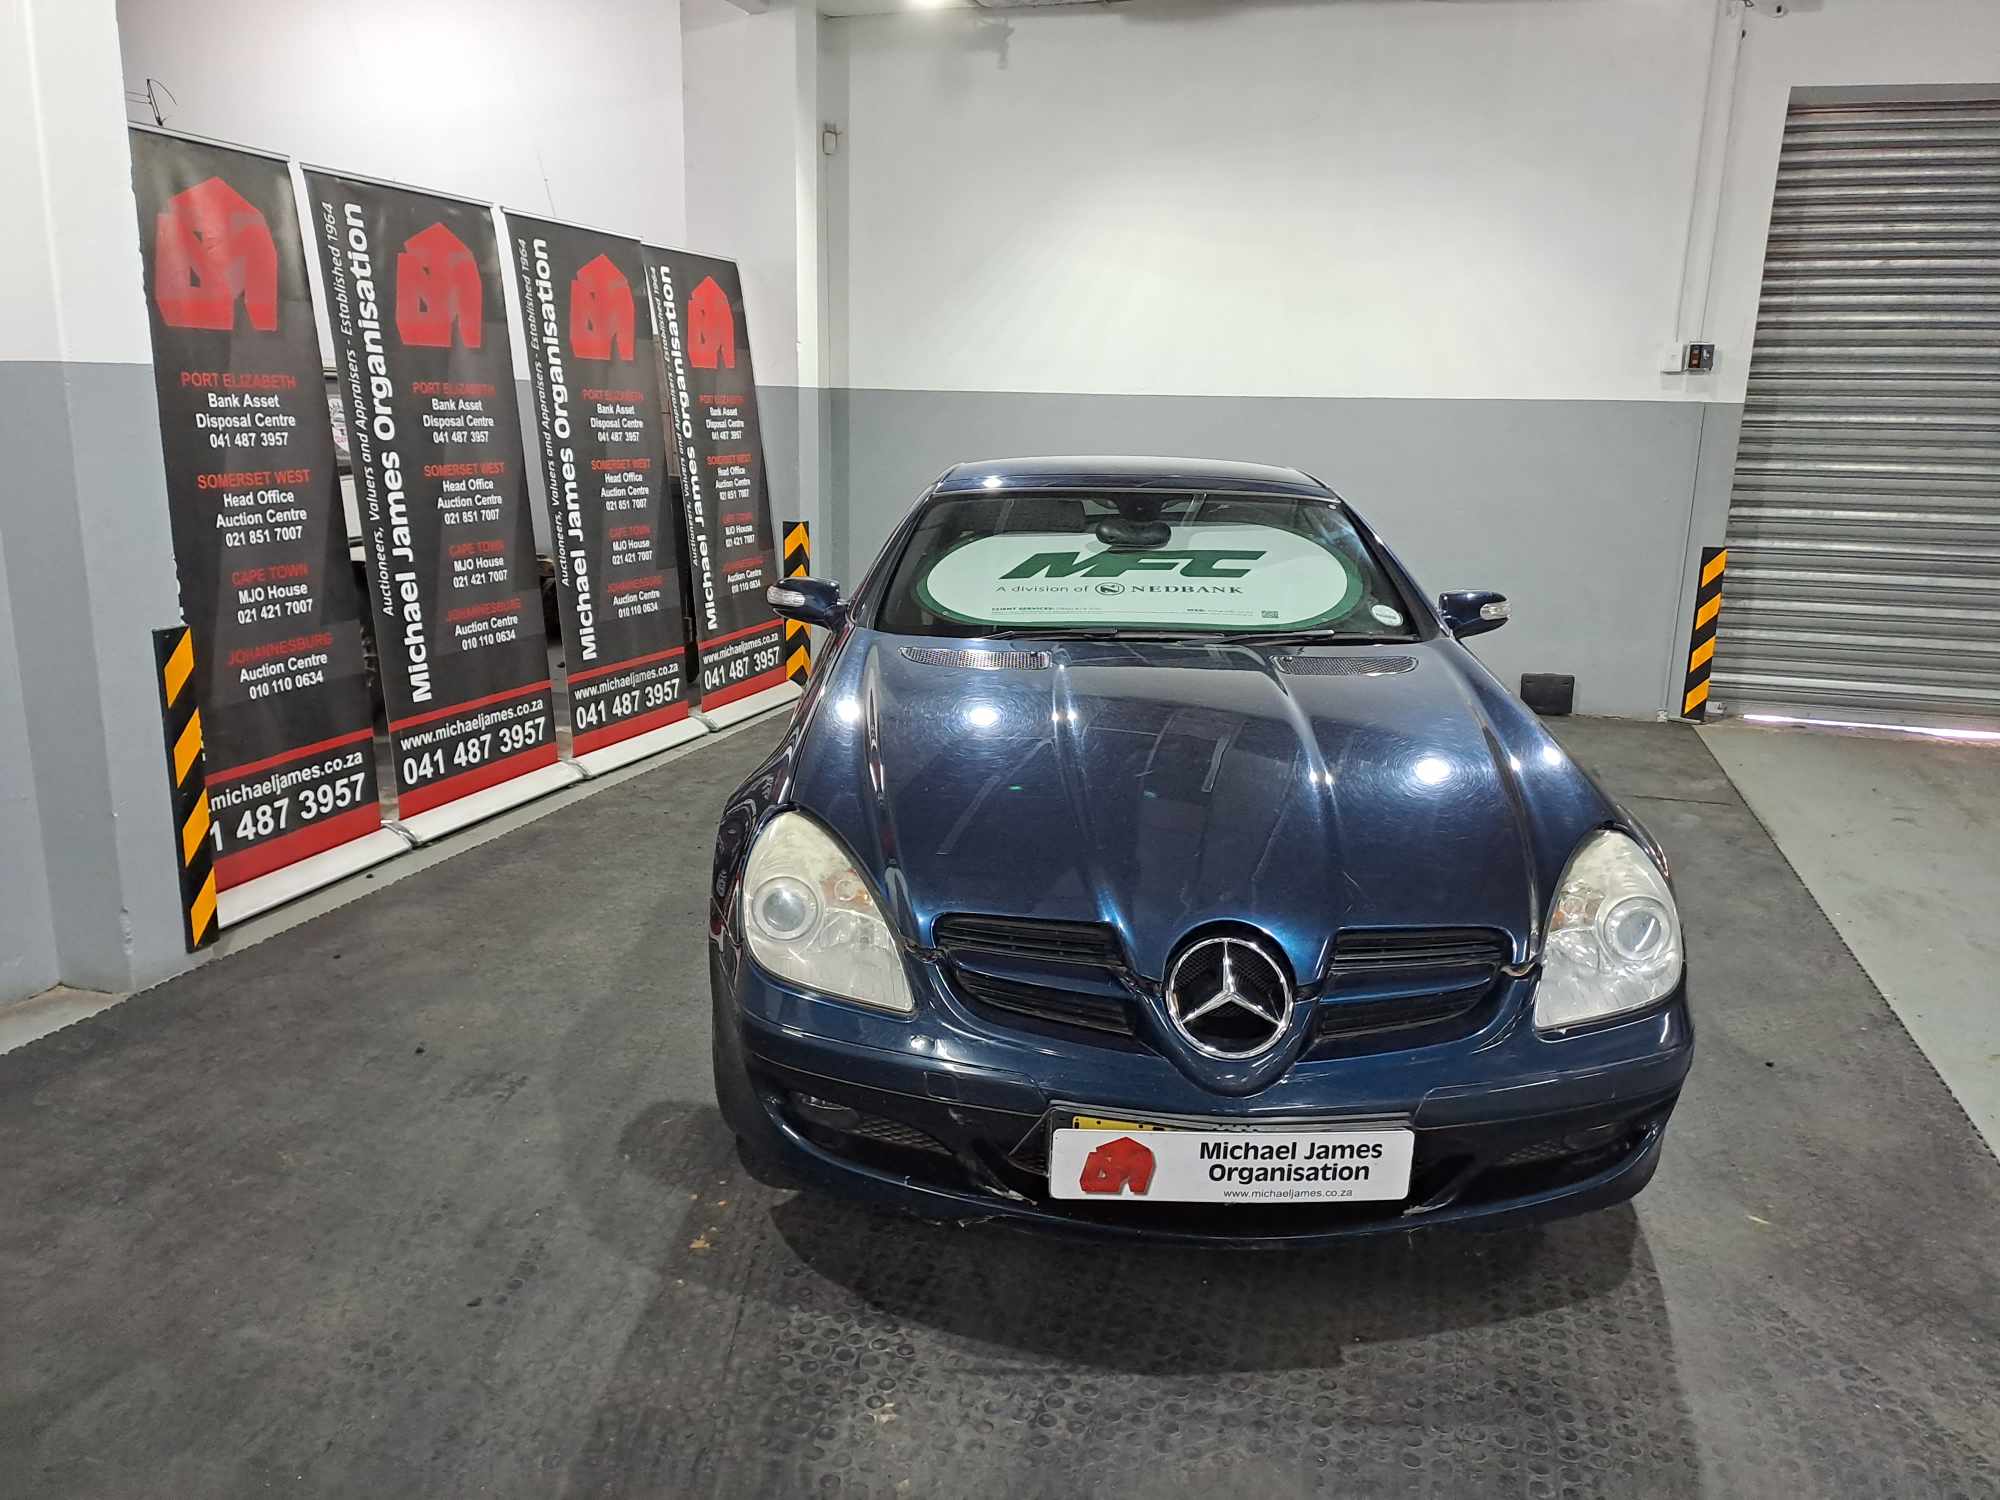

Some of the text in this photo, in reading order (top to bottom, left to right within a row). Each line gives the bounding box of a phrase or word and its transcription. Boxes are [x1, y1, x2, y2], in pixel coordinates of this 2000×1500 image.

[321, 201, 339, 243] 1964
[327, 247, 353, 335] Established
[180, 371, 296, 388] PORT ELIZABETH
[346, 349, 367, 430] Appraisers
[207, 392, 280, 408] Bank Asset
[431, 398, 483, 411] Bank Asset
[195, 412, 296, 431] Disposal Centre
[422, 415, 494, 429] Disposal Centre
[209, 432, 289, 448] 041 487 3957
[358, 433, 372, 462] and
[433, 431, 489, 444] 041 487 3957
[542, 432, 553, 457] and
[344, 202, 433, 704] Michael James Organisation
[197, 469, 311, 489] SOMERSET WEST
[442, 478, 494, 493] Head Office
[548, 461, 561, 506] Valuers
[604, 473, 621, 483] Head
[687, 446, 705, 528] James
[223, 490, 294, 508] Head Office
[364, 467, 380, 521] Valuers
[437, 494, 502, 510] Auction Centre
[560, 447, 584, 542] James
[601, 485, 649, 497] Auction Centre
[216, 507, 307, 529] Auction Centre
[444, 508, 500, 525] 021 851 7007
[225, 526, 303, 547] 021 851 7007
[453, 557, 505, 573] MJO House
[625, 553, 636, 563] 421
[998, 549, 1268, 580] MFC
[231, 564, 309, 586] CAPE TOWN
[453, 569, 508, 589] 021 421 7007
[697, 534, 718, 630] Michael
[238, 583, 308, 604] MJO House
[613, 590, 660, 606] Auction Centre
[995, 585, 1244, 594] A division of NEDBANK
[237, 599, 313, 624] 021 421 7007
[570, 549, 598, 662] Michael
[455, 615, 518, 637] Auction Centre
[461, 629, 516, 651] 010 110 0634
[240, 653, 328, 683] Auction Centre
[704, 646, 780, 690] 041 487 3957
[250, 670, 324, 700] 010 110 0634
[575, 663, 679, 700] www.michaeljames.co.za
[576, 678, 680, 729] 041 487 3957
[400, 698, 544, 751] www.michaeljames.co.za
[403, 716, 546, 785] 041 487 3957
[236, 797, 290, 841] 487
[299, 772, 366, 820] 3957
[1199, 1141, 1383, 1160] Michael James
[1208, 1162, 1370, 1185] Organisation
[1223, 1187, 1353, 1199] www.michaeljames.co.za
